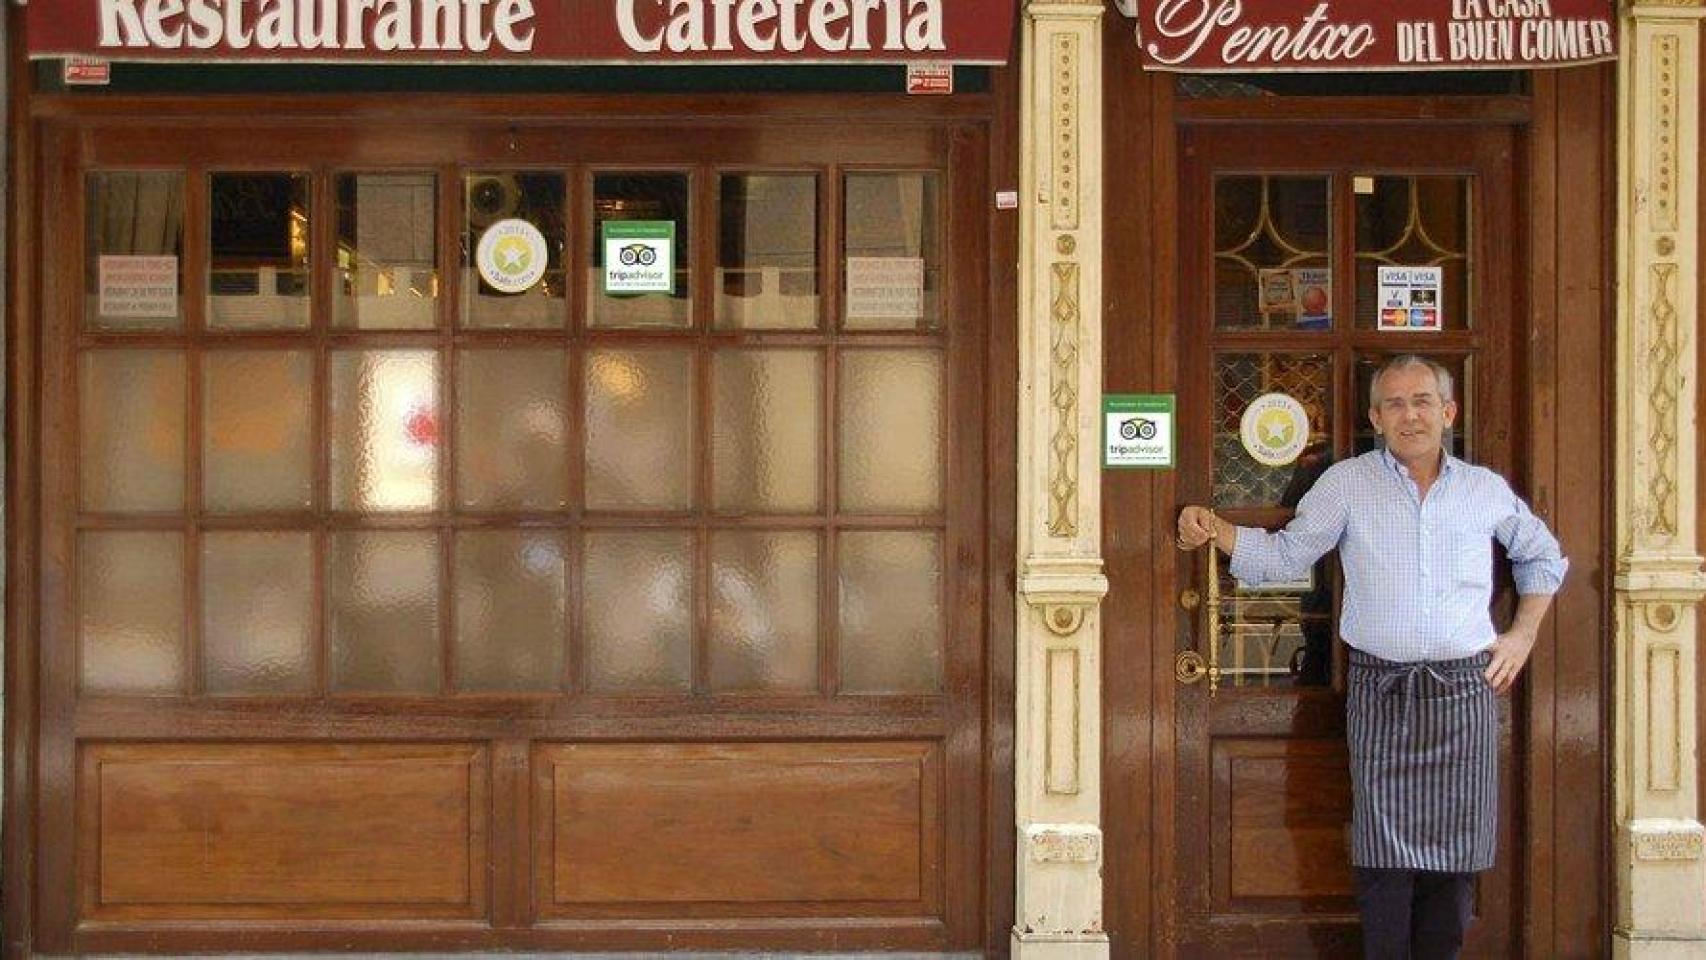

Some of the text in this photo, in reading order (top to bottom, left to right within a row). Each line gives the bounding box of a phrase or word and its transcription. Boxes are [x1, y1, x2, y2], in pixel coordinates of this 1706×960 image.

[99, 0, 536, 51] Restaurante
[1147, 0, 1375, 64] Pentxo
[1396, 19, 1613, 62] DEL BUEN COMER
[609, 269, 664, 281] tripadvisor
[1109, 445, 1164, 456] tripadvisor
